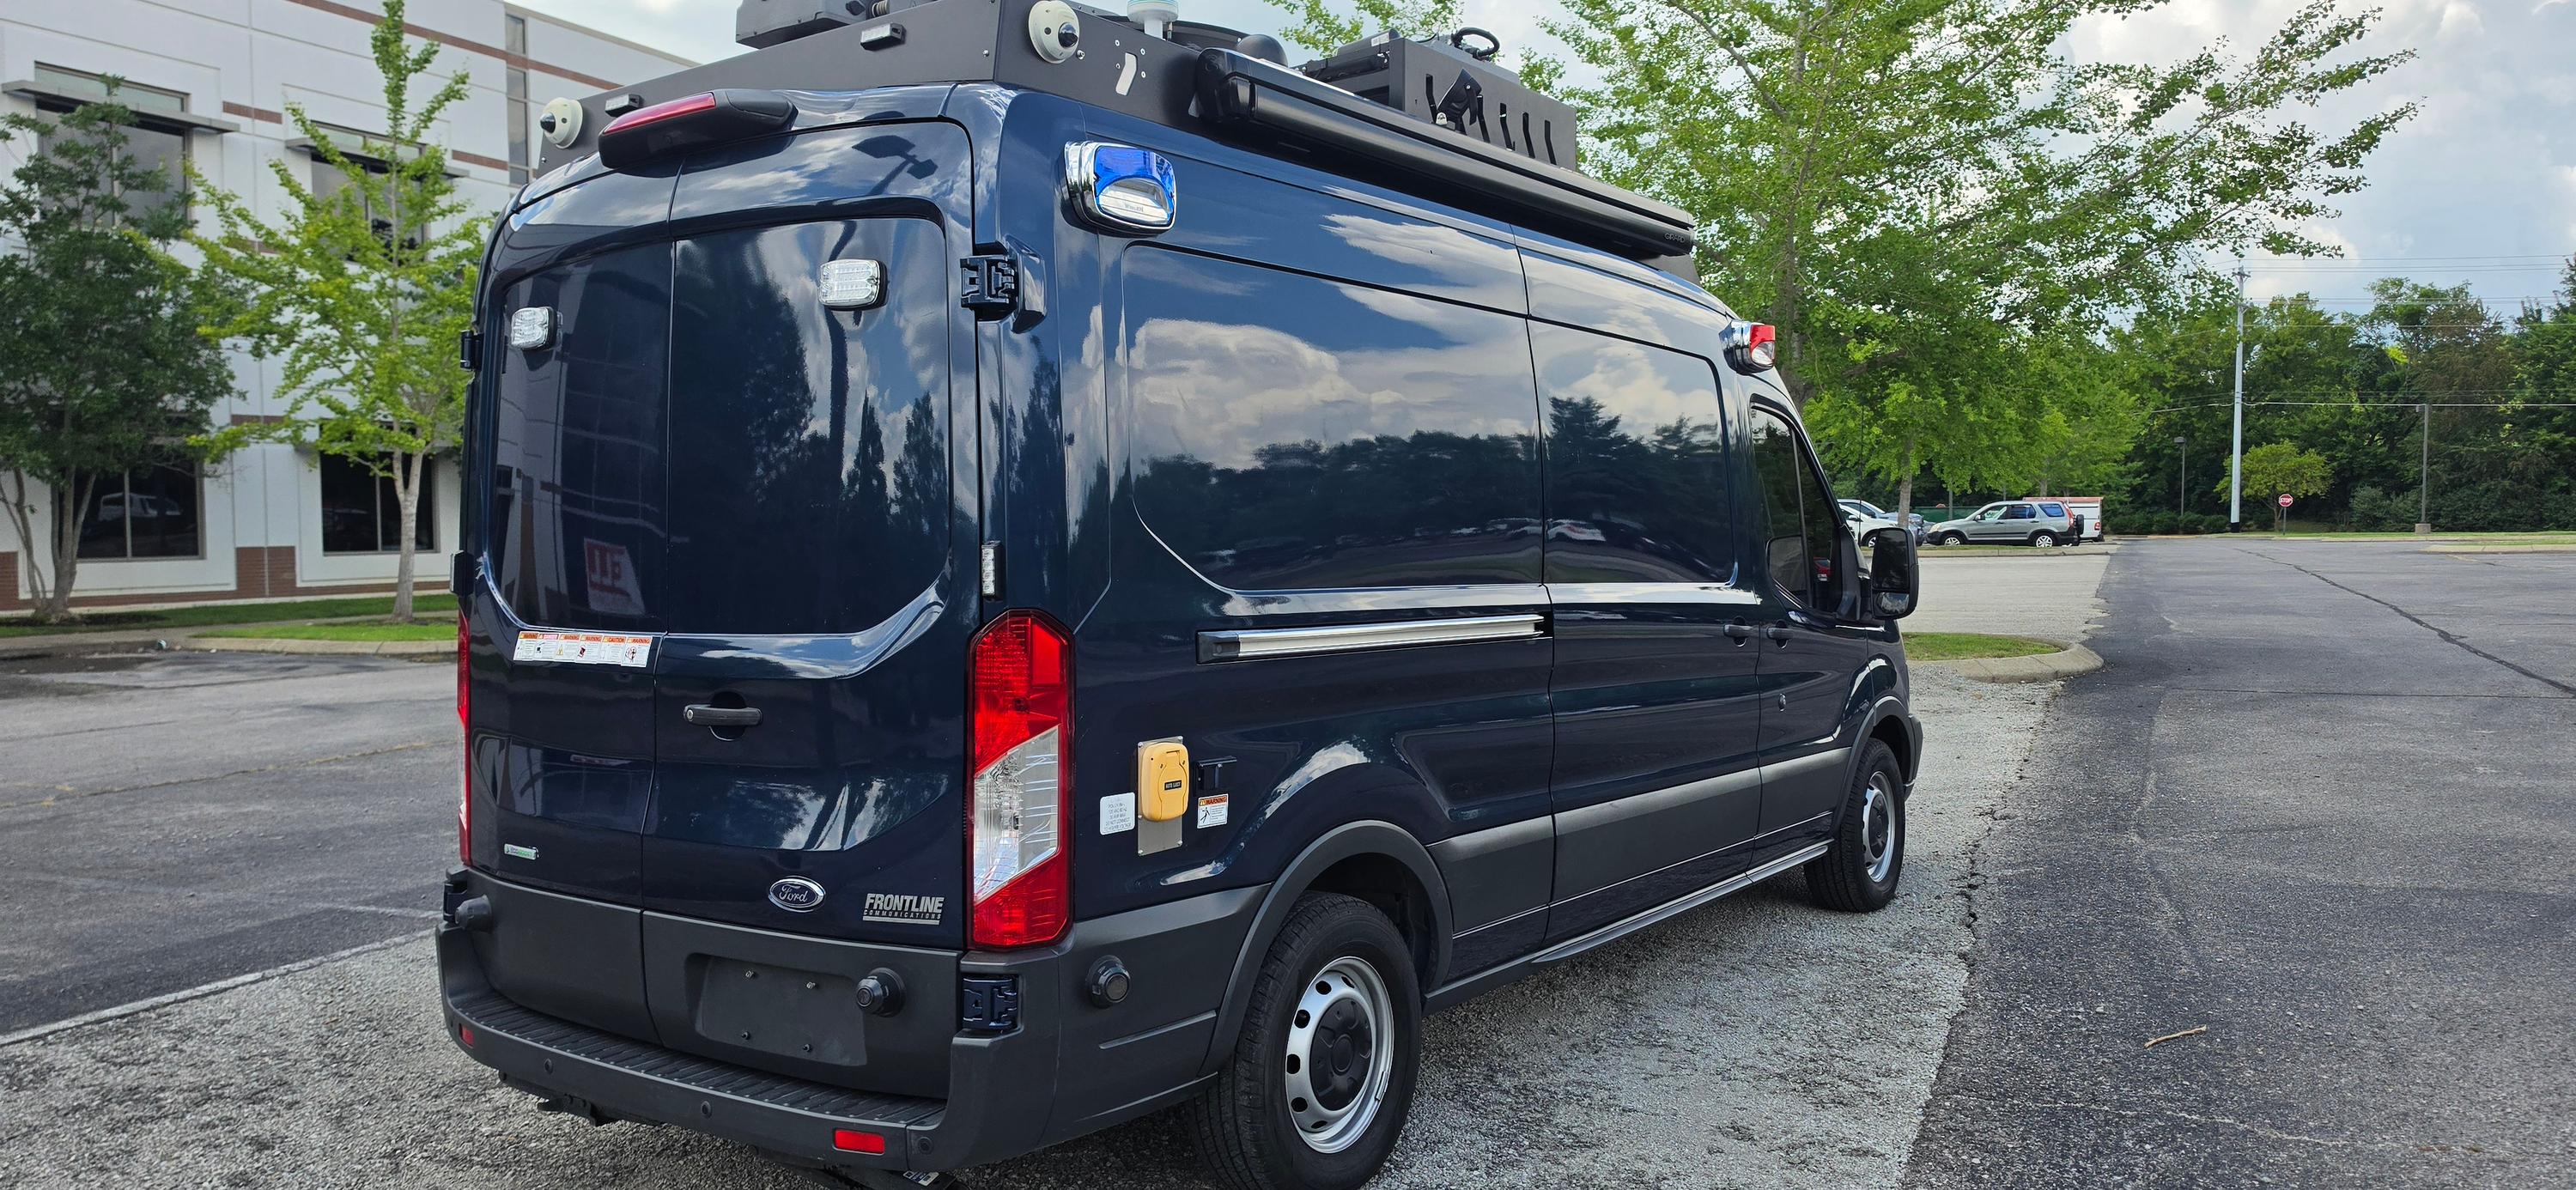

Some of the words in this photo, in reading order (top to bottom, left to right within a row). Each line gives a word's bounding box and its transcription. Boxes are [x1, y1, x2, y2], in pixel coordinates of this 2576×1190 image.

[1206, 796, 1227, 805] WARNING
[779, 884, 809, 902] Ford
[864, 893, 945, 914] FRONTLINE
[863, 909, 942, 920] COMMUNICATIONS
